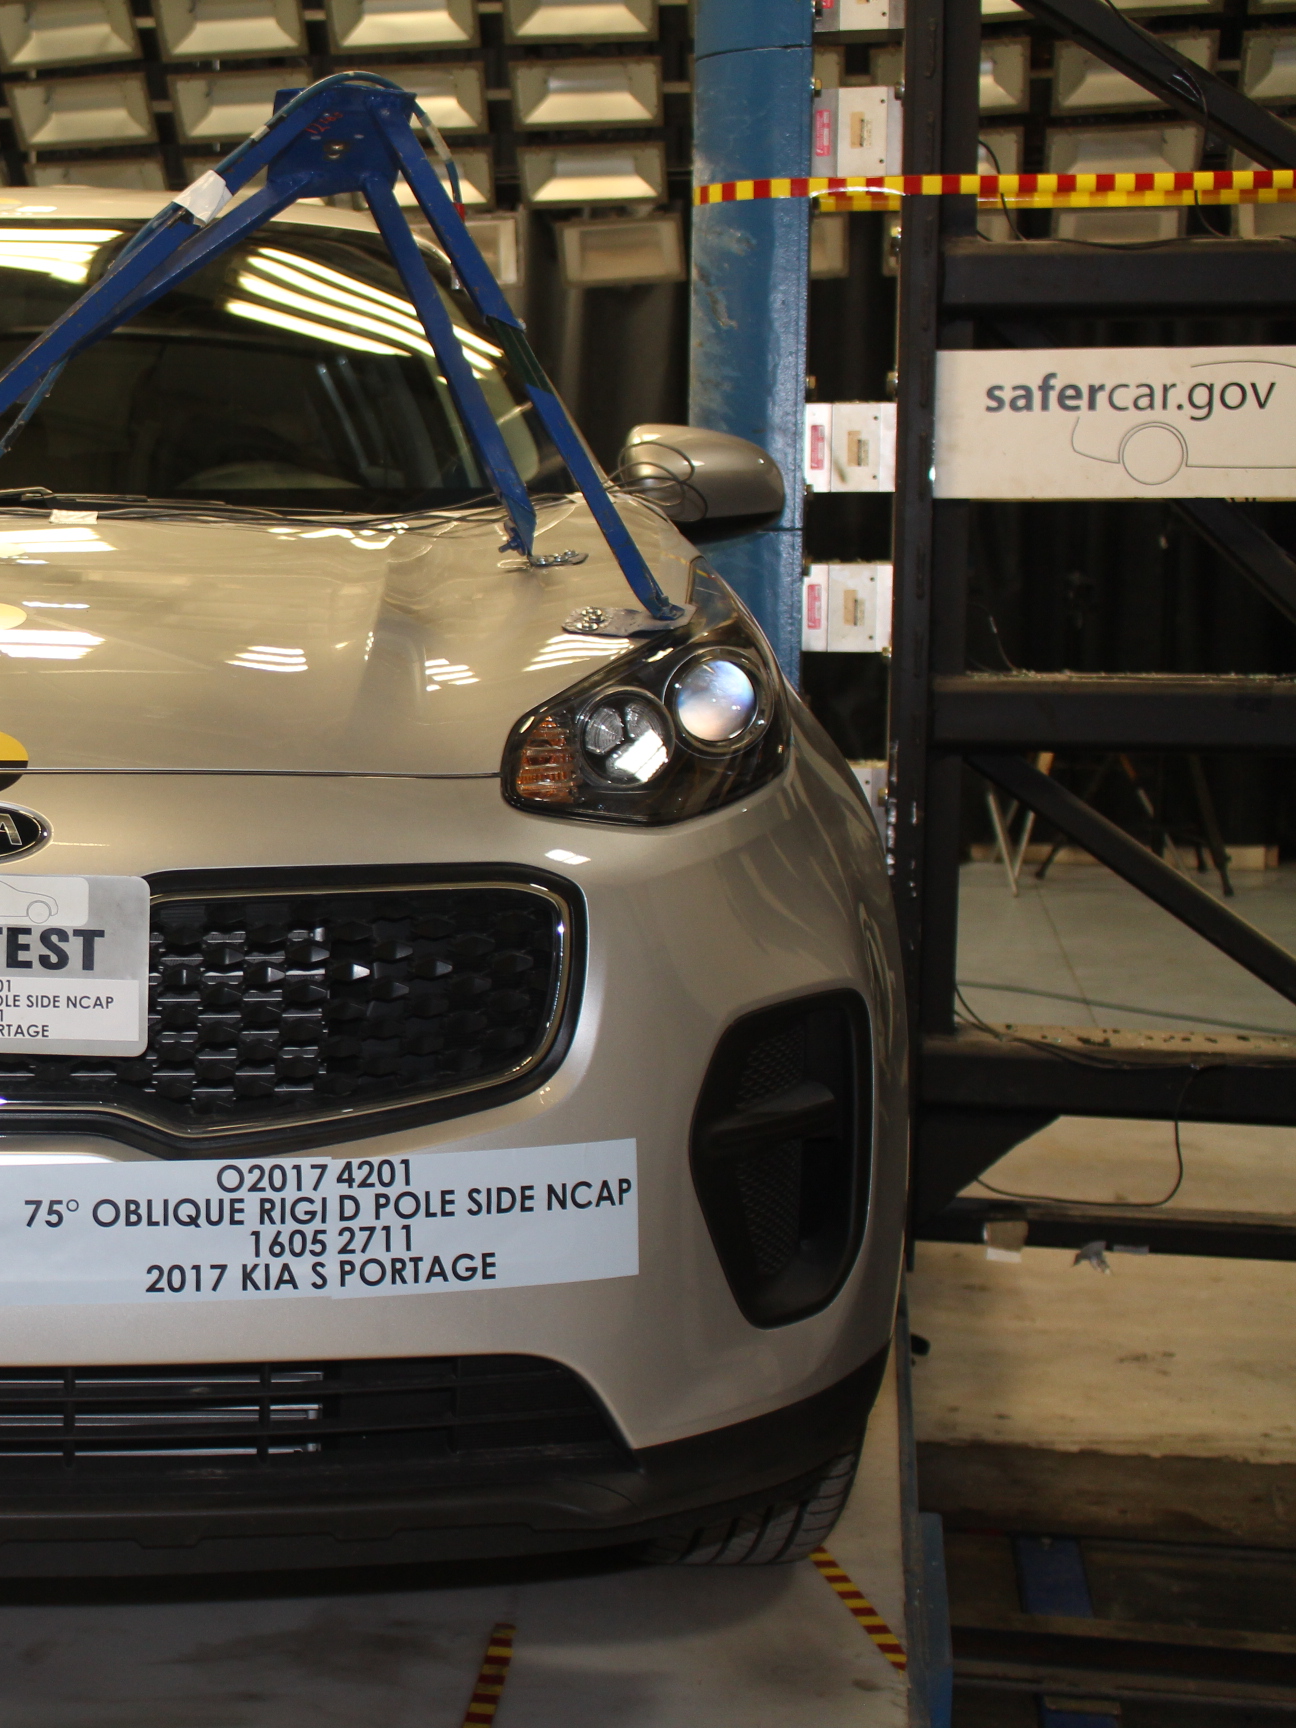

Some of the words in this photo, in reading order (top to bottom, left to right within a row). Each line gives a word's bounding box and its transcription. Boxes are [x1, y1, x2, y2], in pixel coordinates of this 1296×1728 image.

[985, 372, 1277, 422] safercar.gov
[26, 995, 60, 1009] SIDE
[66, 995, 114, 1010] NCAP
[24, 1199, 79, 1228] 75°
[92, 1198, 245, 1228] OBLIQUE
[374, 1189, 456, 1221] POLE
[467, 1184, 535, 1217] SIDE
[547, 1178, 633, 1211] NCAP
[145, 1264, 228, 1293] 2017
[241, 1262, 299, 1292] KIA
